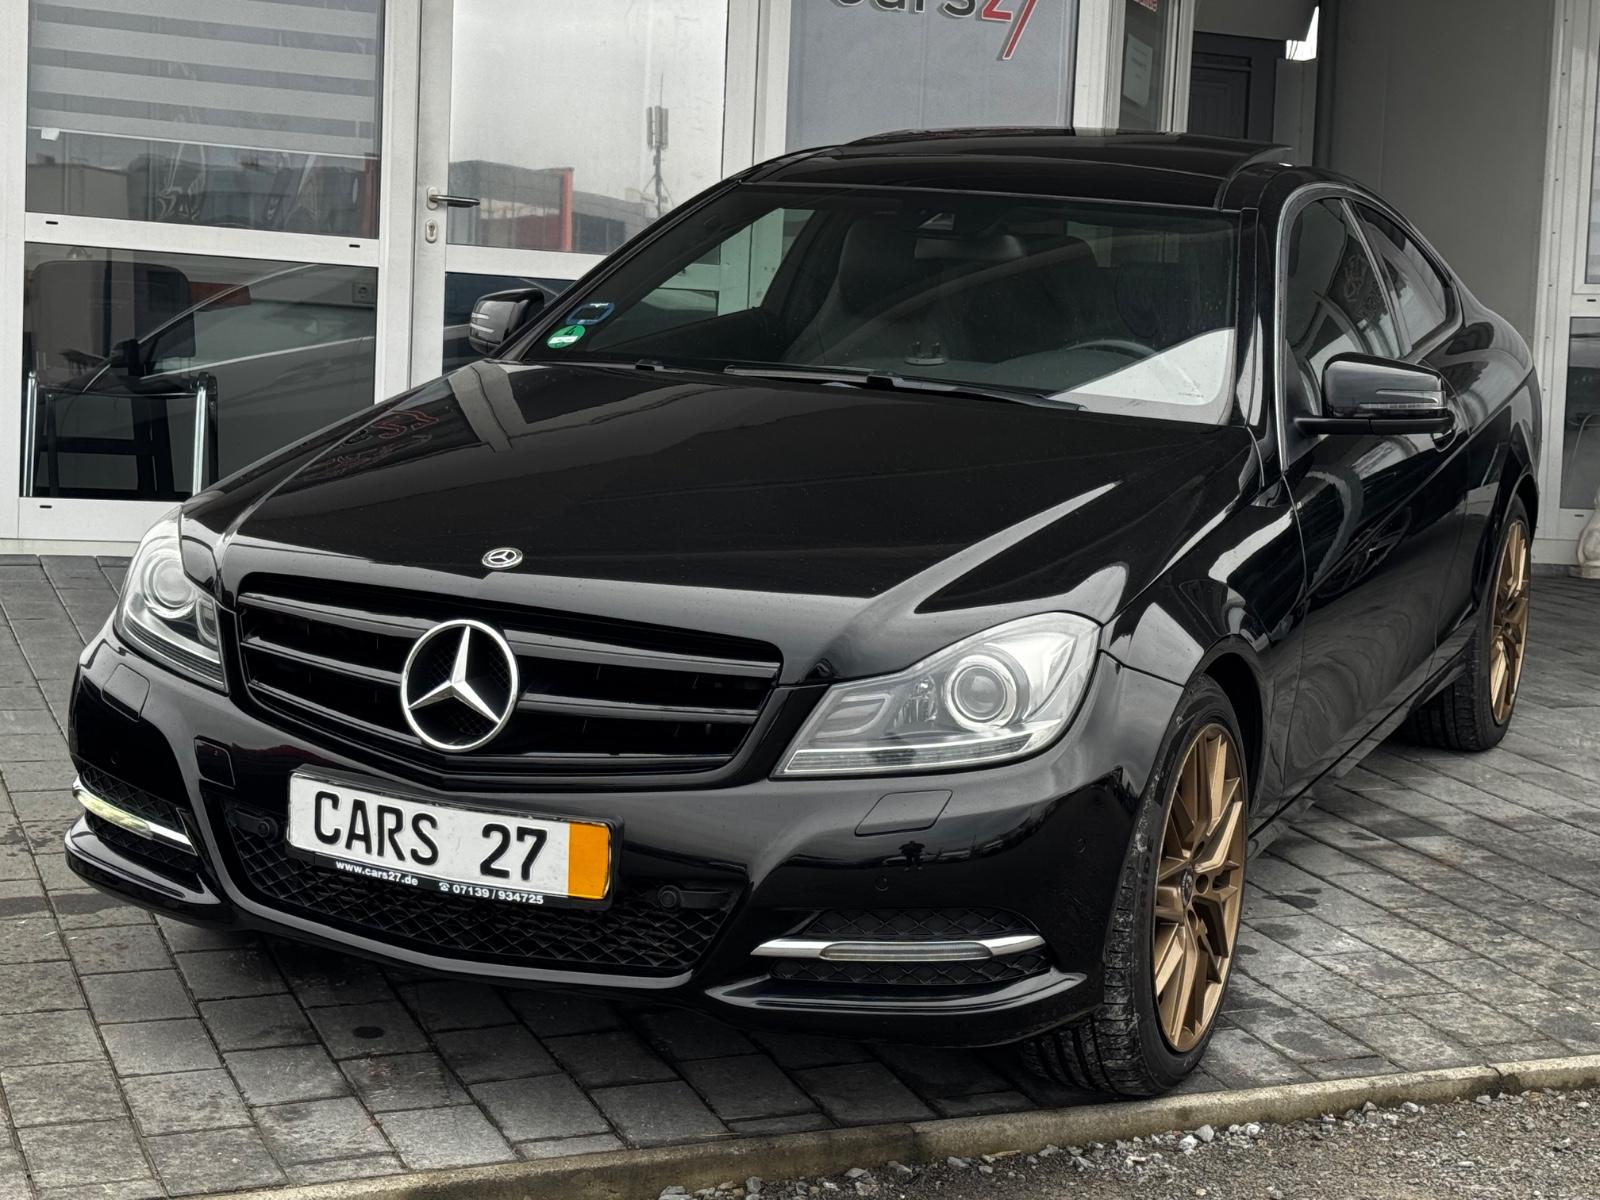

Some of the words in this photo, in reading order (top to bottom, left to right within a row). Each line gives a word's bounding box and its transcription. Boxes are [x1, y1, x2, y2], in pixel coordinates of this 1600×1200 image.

[314, 790, 439, 866] CARS
[480, 823, 547, 881] 27
[335, 861, 419, 886] www.cars27.de
[452, 884, 489, 898] 07139
[497, 890, 544, 904] 934725
